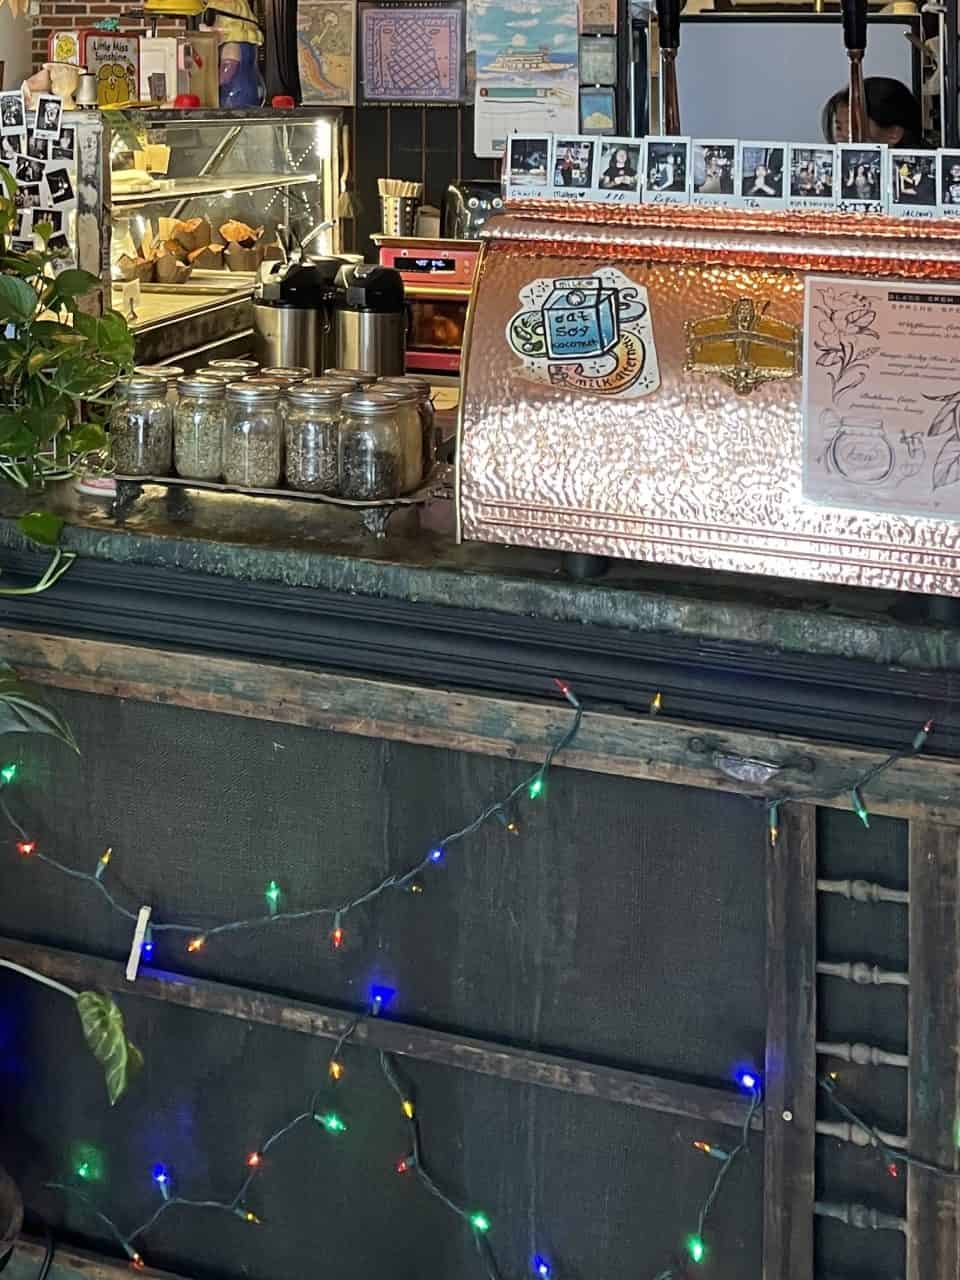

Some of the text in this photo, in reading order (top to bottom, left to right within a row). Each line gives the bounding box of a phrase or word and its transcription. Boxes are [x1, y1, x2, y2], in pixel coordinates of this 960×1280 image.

[93, 40, 128, 52] Little Miss
[95, 51, 127, 61] Sunshine
